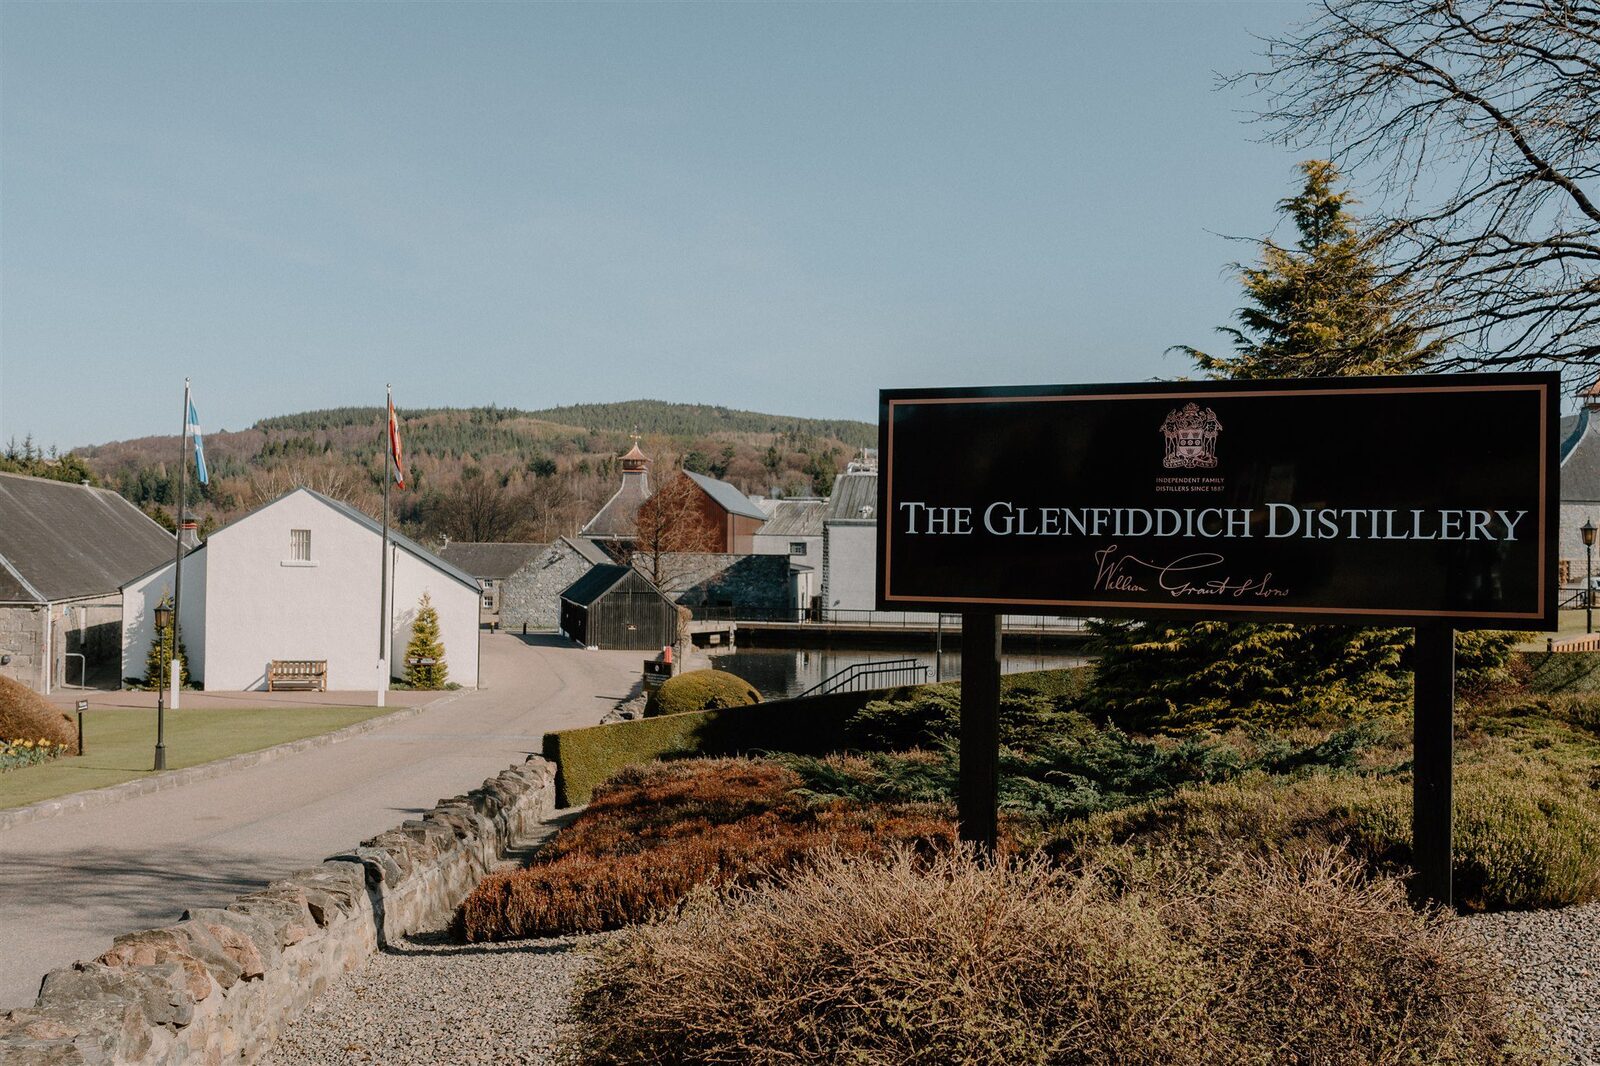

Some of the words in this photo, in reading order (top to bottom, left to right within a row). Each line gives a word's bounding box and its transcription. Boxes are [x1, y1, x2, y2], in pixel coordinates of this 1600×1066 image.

[899, 501, 974, 535] THE
[983, 501, 1254, 538] GLENFIDDICH
[1264, 502, 1529, 541] DISTILLERY
[1093, 544, 1148, 592] William
[1159, 552, 1230, 597] Grant
[1255, 572, 1290, 598] Sons
